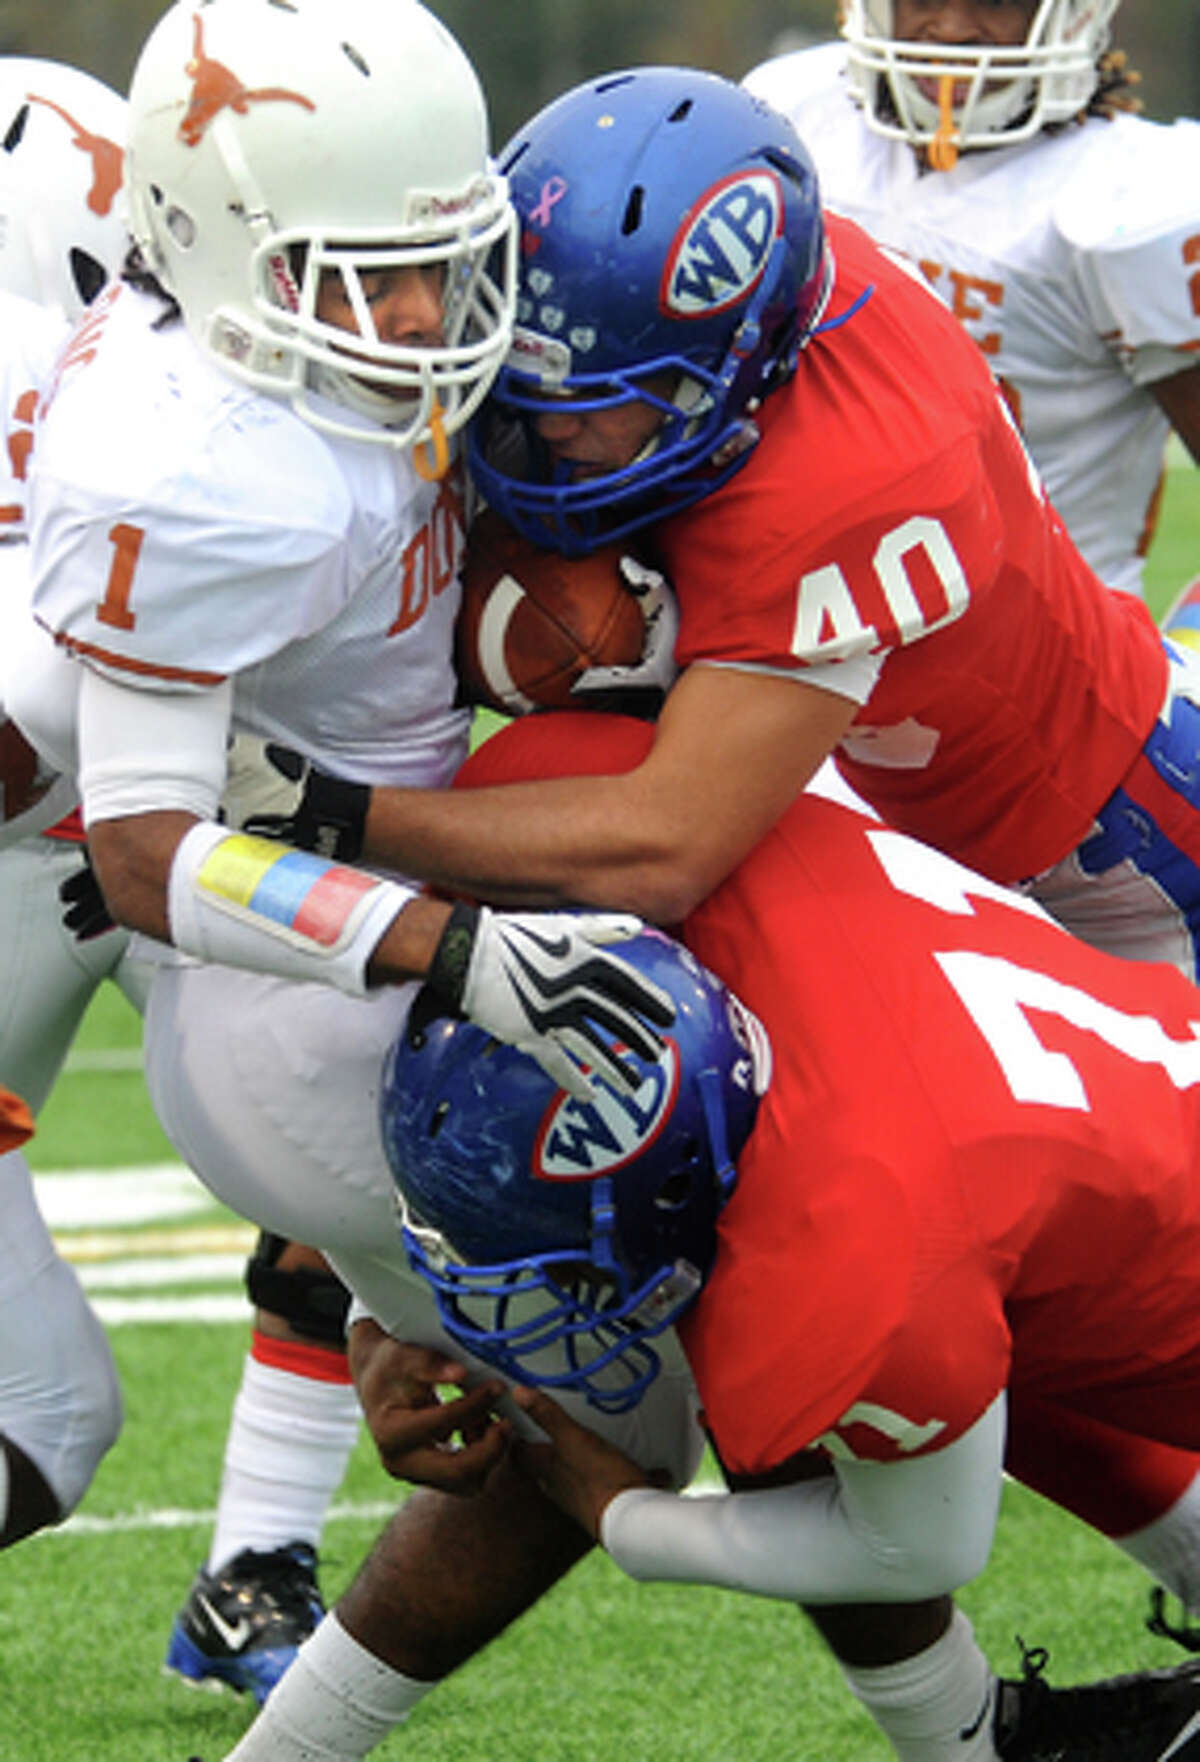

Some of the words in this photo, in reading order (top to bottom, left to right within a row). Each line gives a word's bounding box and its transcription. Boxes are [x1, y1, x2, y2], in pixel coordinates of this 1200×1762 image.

[674, 184, 773, 304] WB
[96, 523, 145, 632] 1
[387, 494, 468, 637] DO
[790, 515, 971, 664] 40
